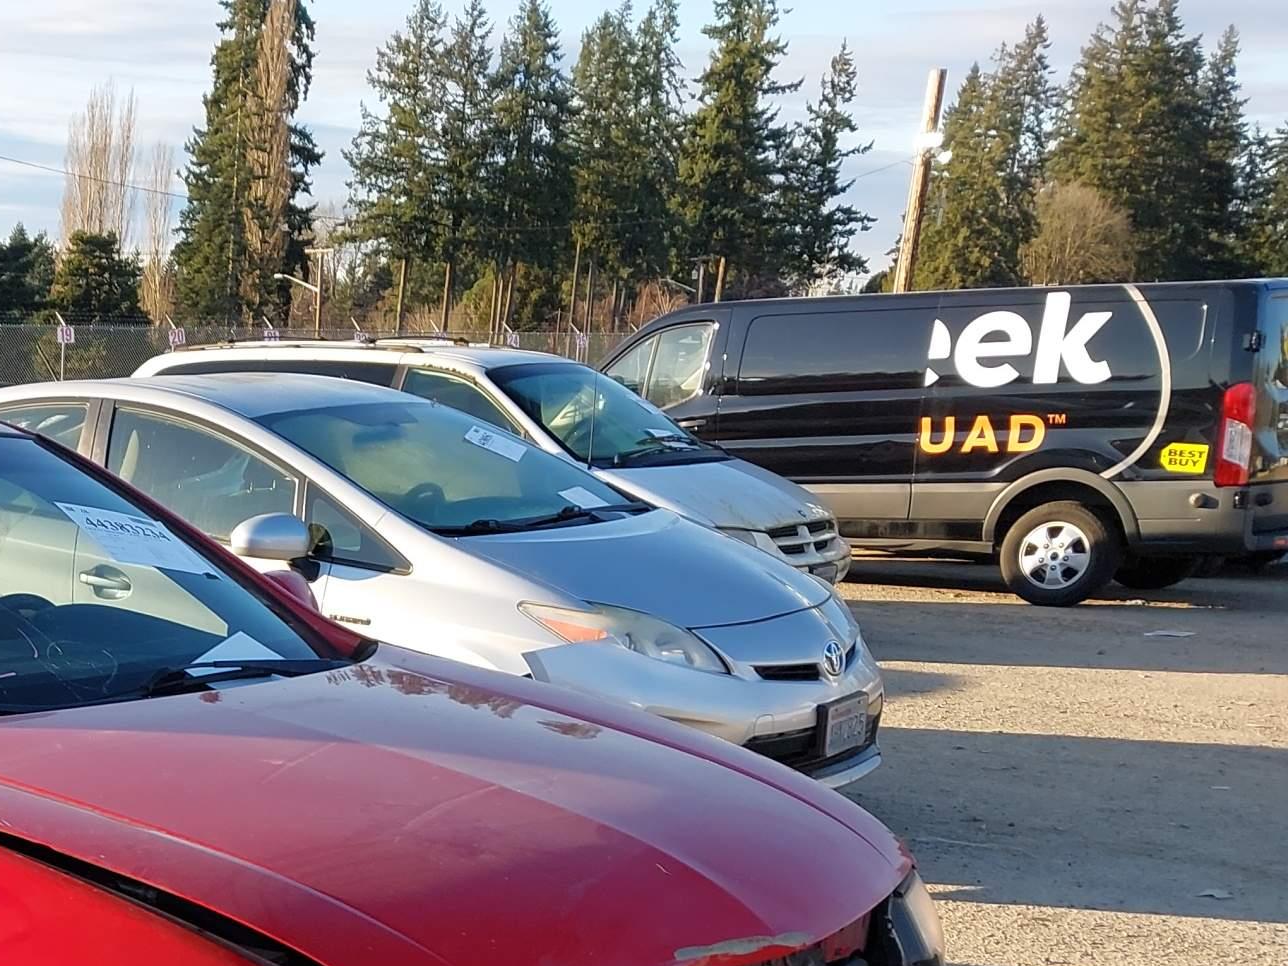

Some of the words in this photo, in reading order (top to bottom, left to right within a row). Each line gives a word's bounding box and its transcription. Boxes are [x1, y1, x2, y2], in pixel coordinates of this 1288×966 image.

[60, 327, 72, 342] 19
[171, 330, 184, 345] 20
[1168, 448, 1206, 458] BEST
[1168, 457, 1200, 467] BUY
[85, 516, 171, 542] 44383234
